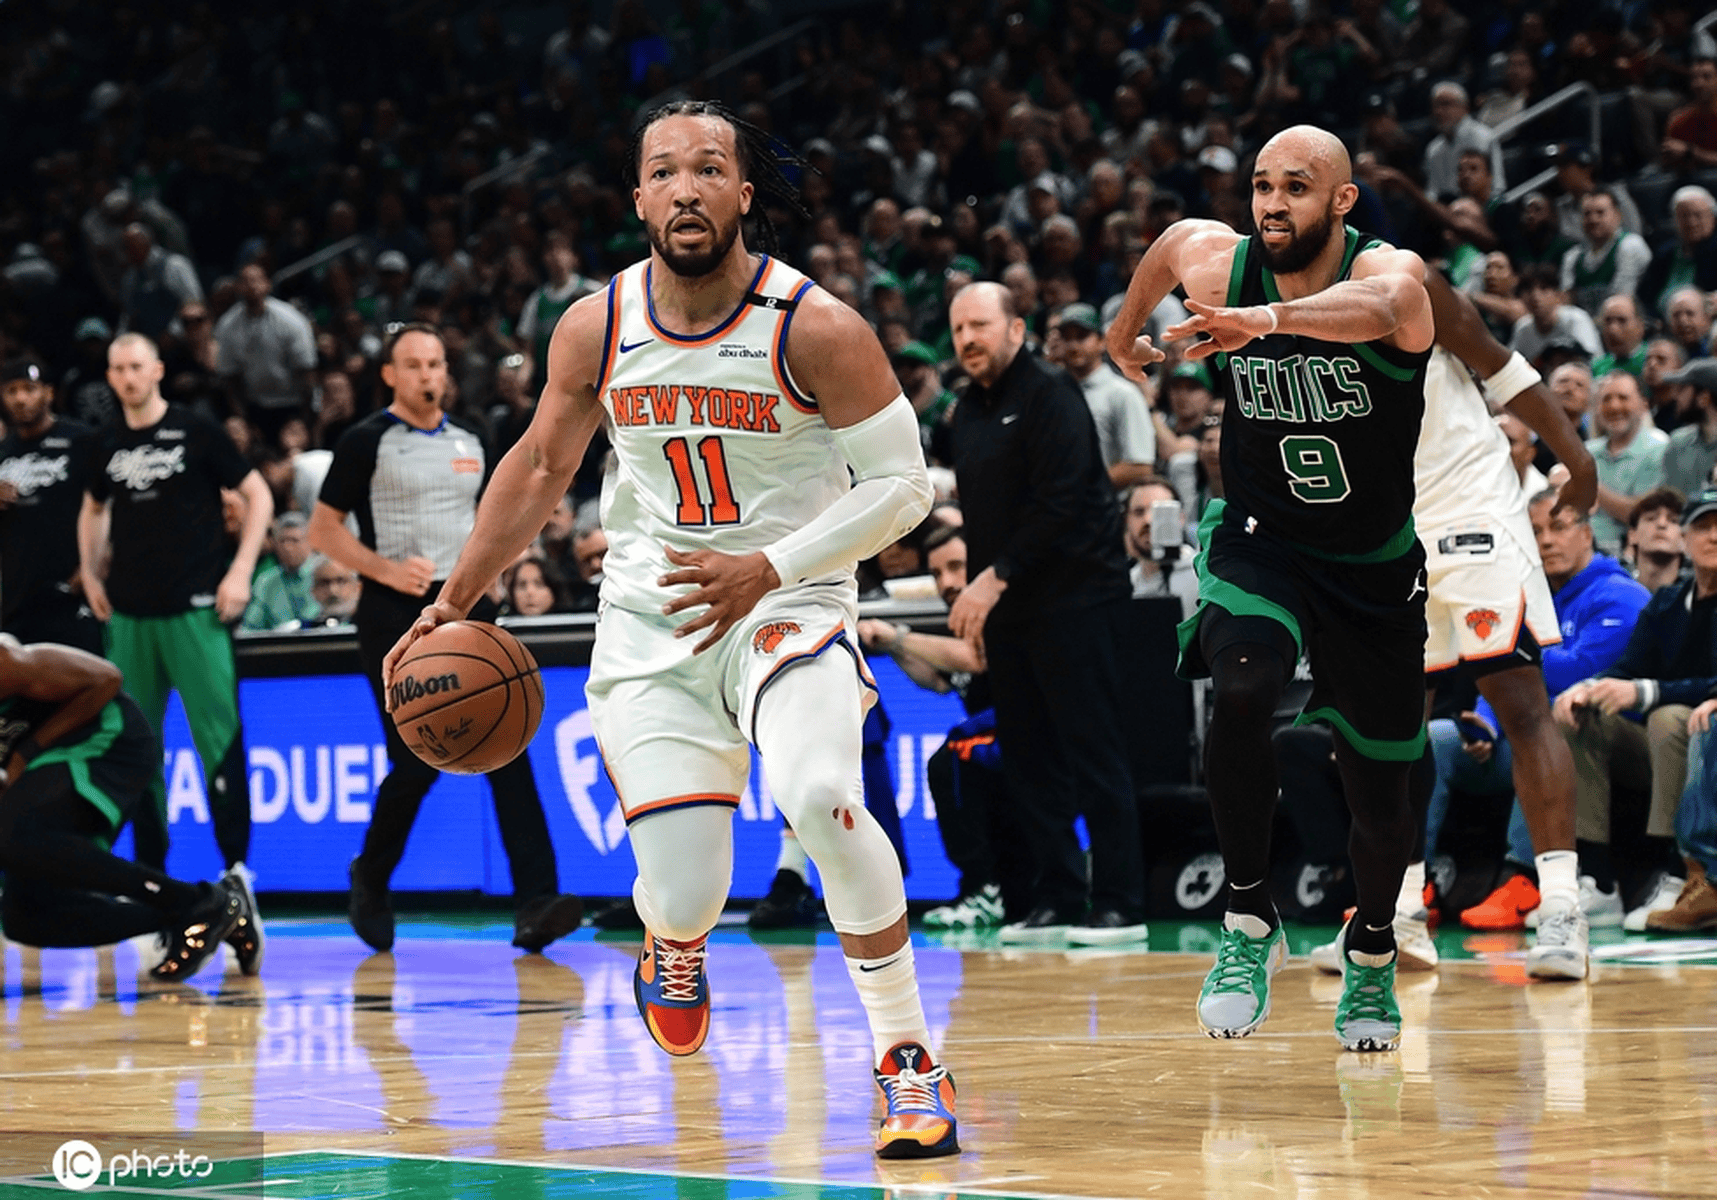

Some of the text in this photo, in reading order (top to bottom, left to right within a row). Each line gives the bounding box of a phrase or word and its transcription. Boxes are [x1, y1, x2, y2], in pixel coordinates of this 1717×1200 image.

[610, 385, 781, 433] NEW YORK
[1230, 353, 1373, 423] CELTICS
[662, 435, 741, 526] 11
[1279, 435, 1351, 503] 9
